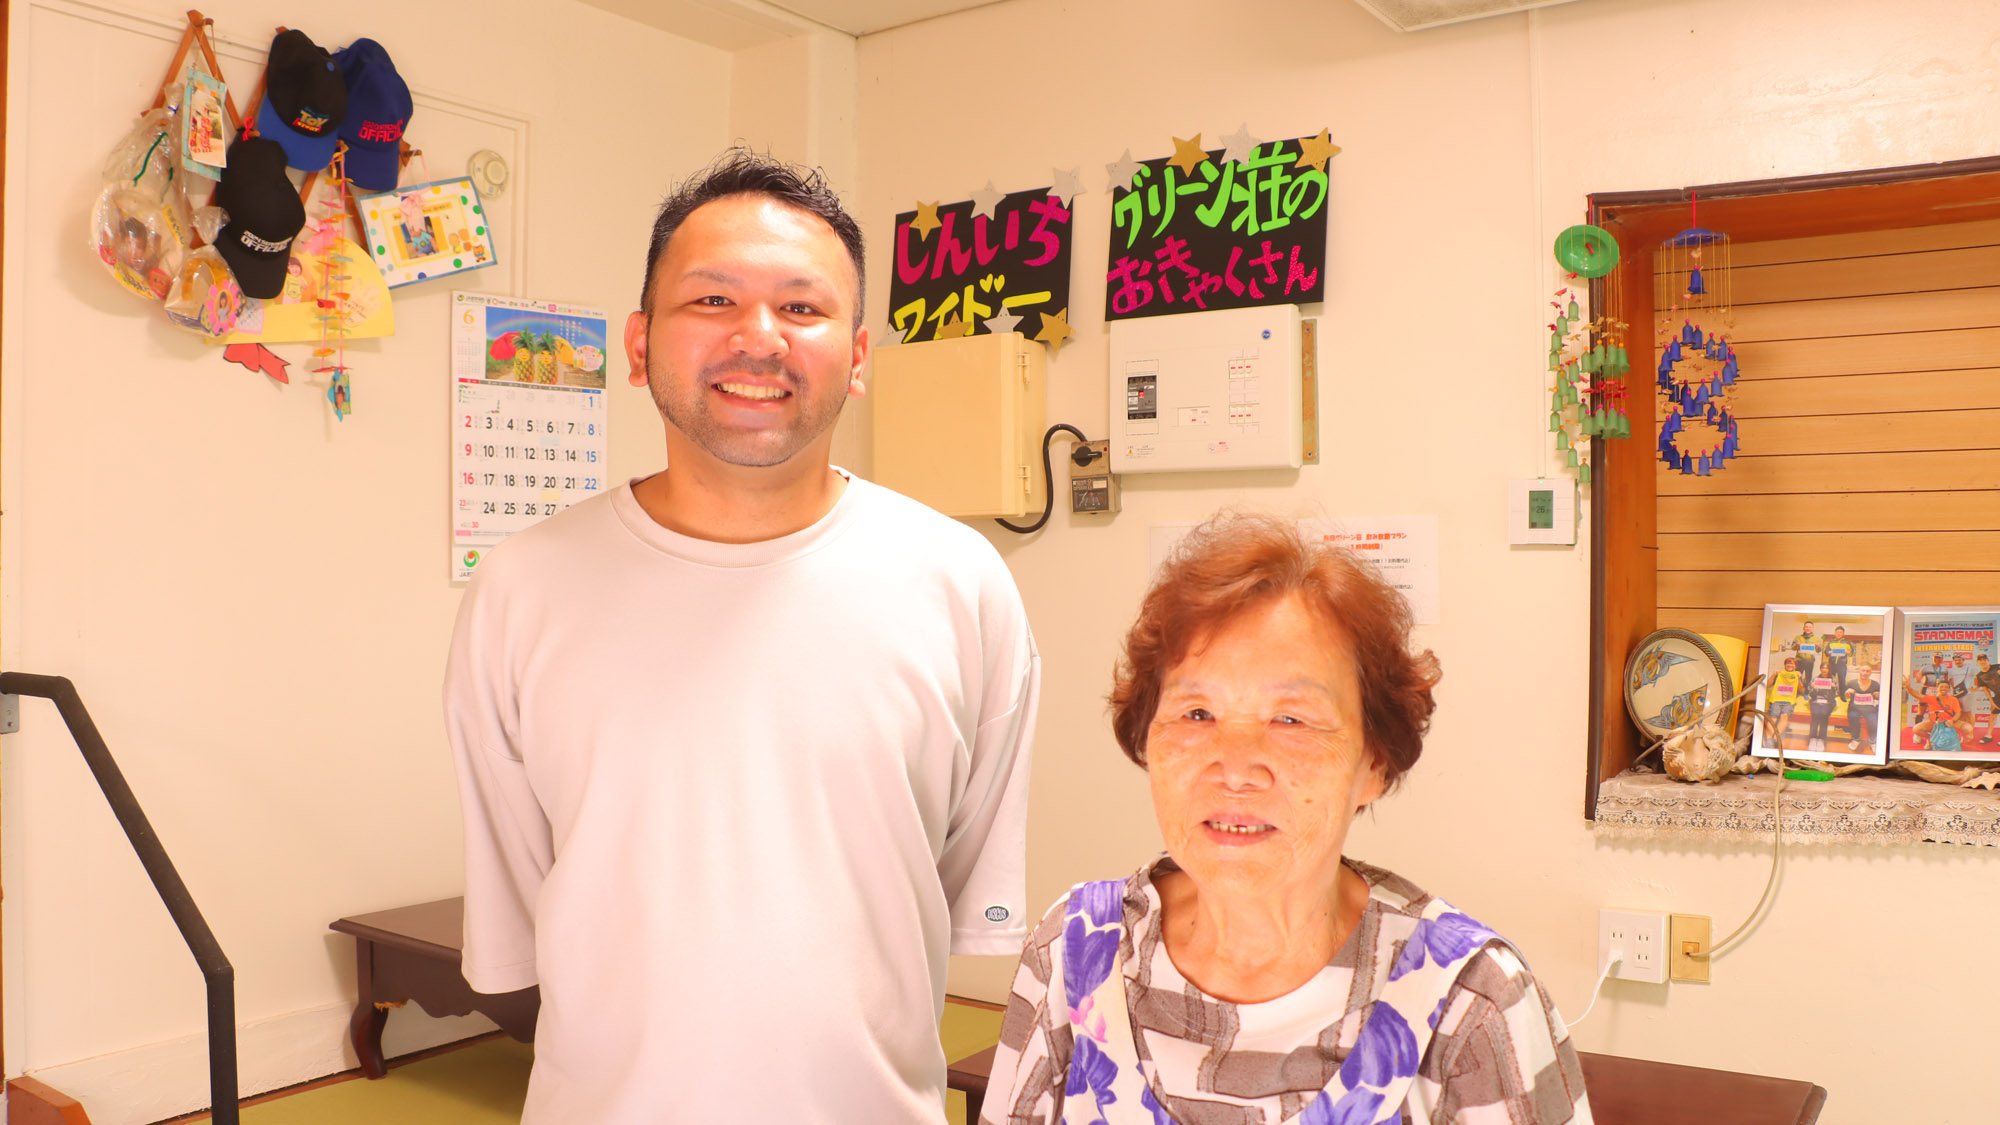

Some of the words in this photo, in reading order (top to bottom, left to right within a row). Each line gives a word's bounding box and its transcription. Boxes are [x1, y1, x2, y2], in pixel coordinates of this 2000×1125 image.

[1114, 140, 1329, 250] グリーン荘の
[897, 196, 1071, 285] しんいち
[1107, 235, 1318, 314] おきゃくさん
[463, 308, 475, 325] 6
[894, 273, 1052, 344] ワイドー
[589, 396, 594, 408] 1
[465, 415, 472, 428] 2
[486, 417, 493, 429] 3
[507, 418, 514, 430] 4
[526, 420, 534, 432] 5
[546, 421, 554, 433] 6
[567, 422, 575, 434] 7
[588, 423, 595, 436] 8
[465, 443, 472, 456] 9
[483, 445, 495, 457] 10
[505, 446, 515, 459] 11
[524, 448, 536, 460] 12
[545, 449, 556, 461] 13
[565, 450, 576, 462] 14
[586, 451, 597, 463] 15
[463, 472, 475, 485] 16
[484, 473, 495, 486] 17
[504, 474, 515, 487] 18
[525, 475, 536, 487] 19
[544, 476, 556, 488] 20
[565, 477, 576, 489] 21
[585, 478, 597, 490] 22
[483, 502, 495, 514] 24
[504, 502, 516, 515] 25
[525, 503, 536, 515] 26
[544, 504, 556, 516] 27
[1536, 505, 1545, 514] 26
[1914, 630, 1994, 641] STRONGMAN
[1914, 644, 1951, 652] INTERVIEW
